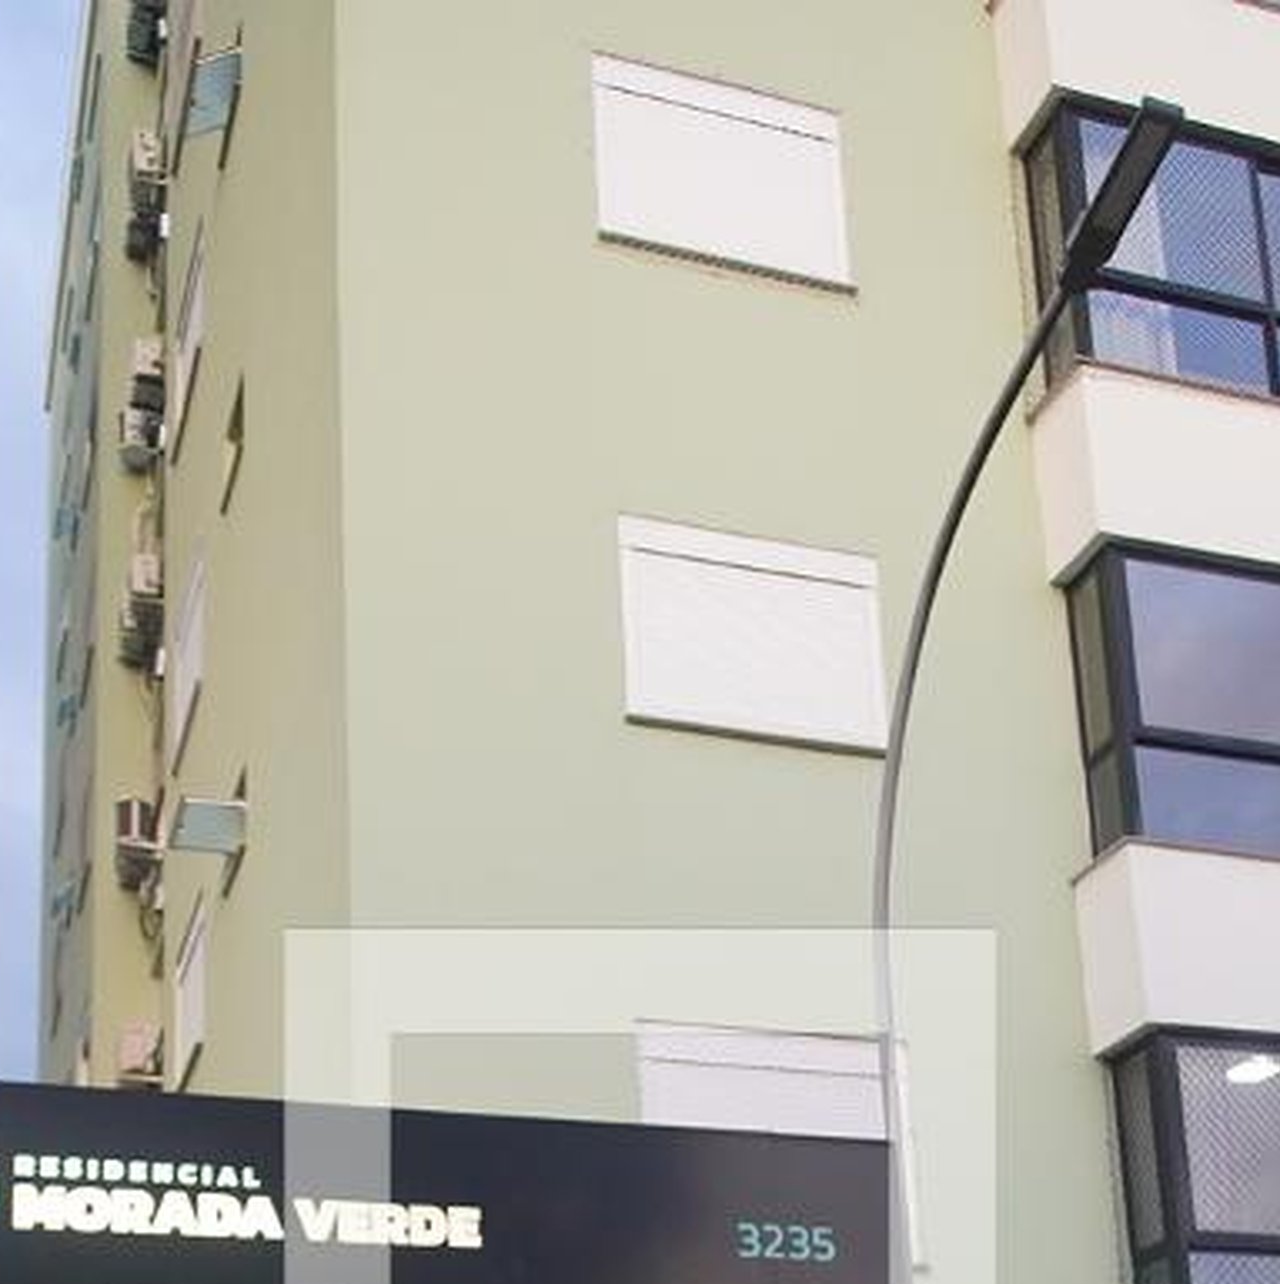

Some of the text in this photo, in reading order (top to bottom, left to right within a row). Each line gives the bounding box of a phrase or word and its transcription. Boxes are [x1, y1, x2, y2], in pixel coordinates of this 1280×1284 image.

[13, 1154, 261, 1188] RESIDENCIAL
[12, 1183, 483, 1248] MORADA VERDE
[738, 1222, 836, 1261] 3235
